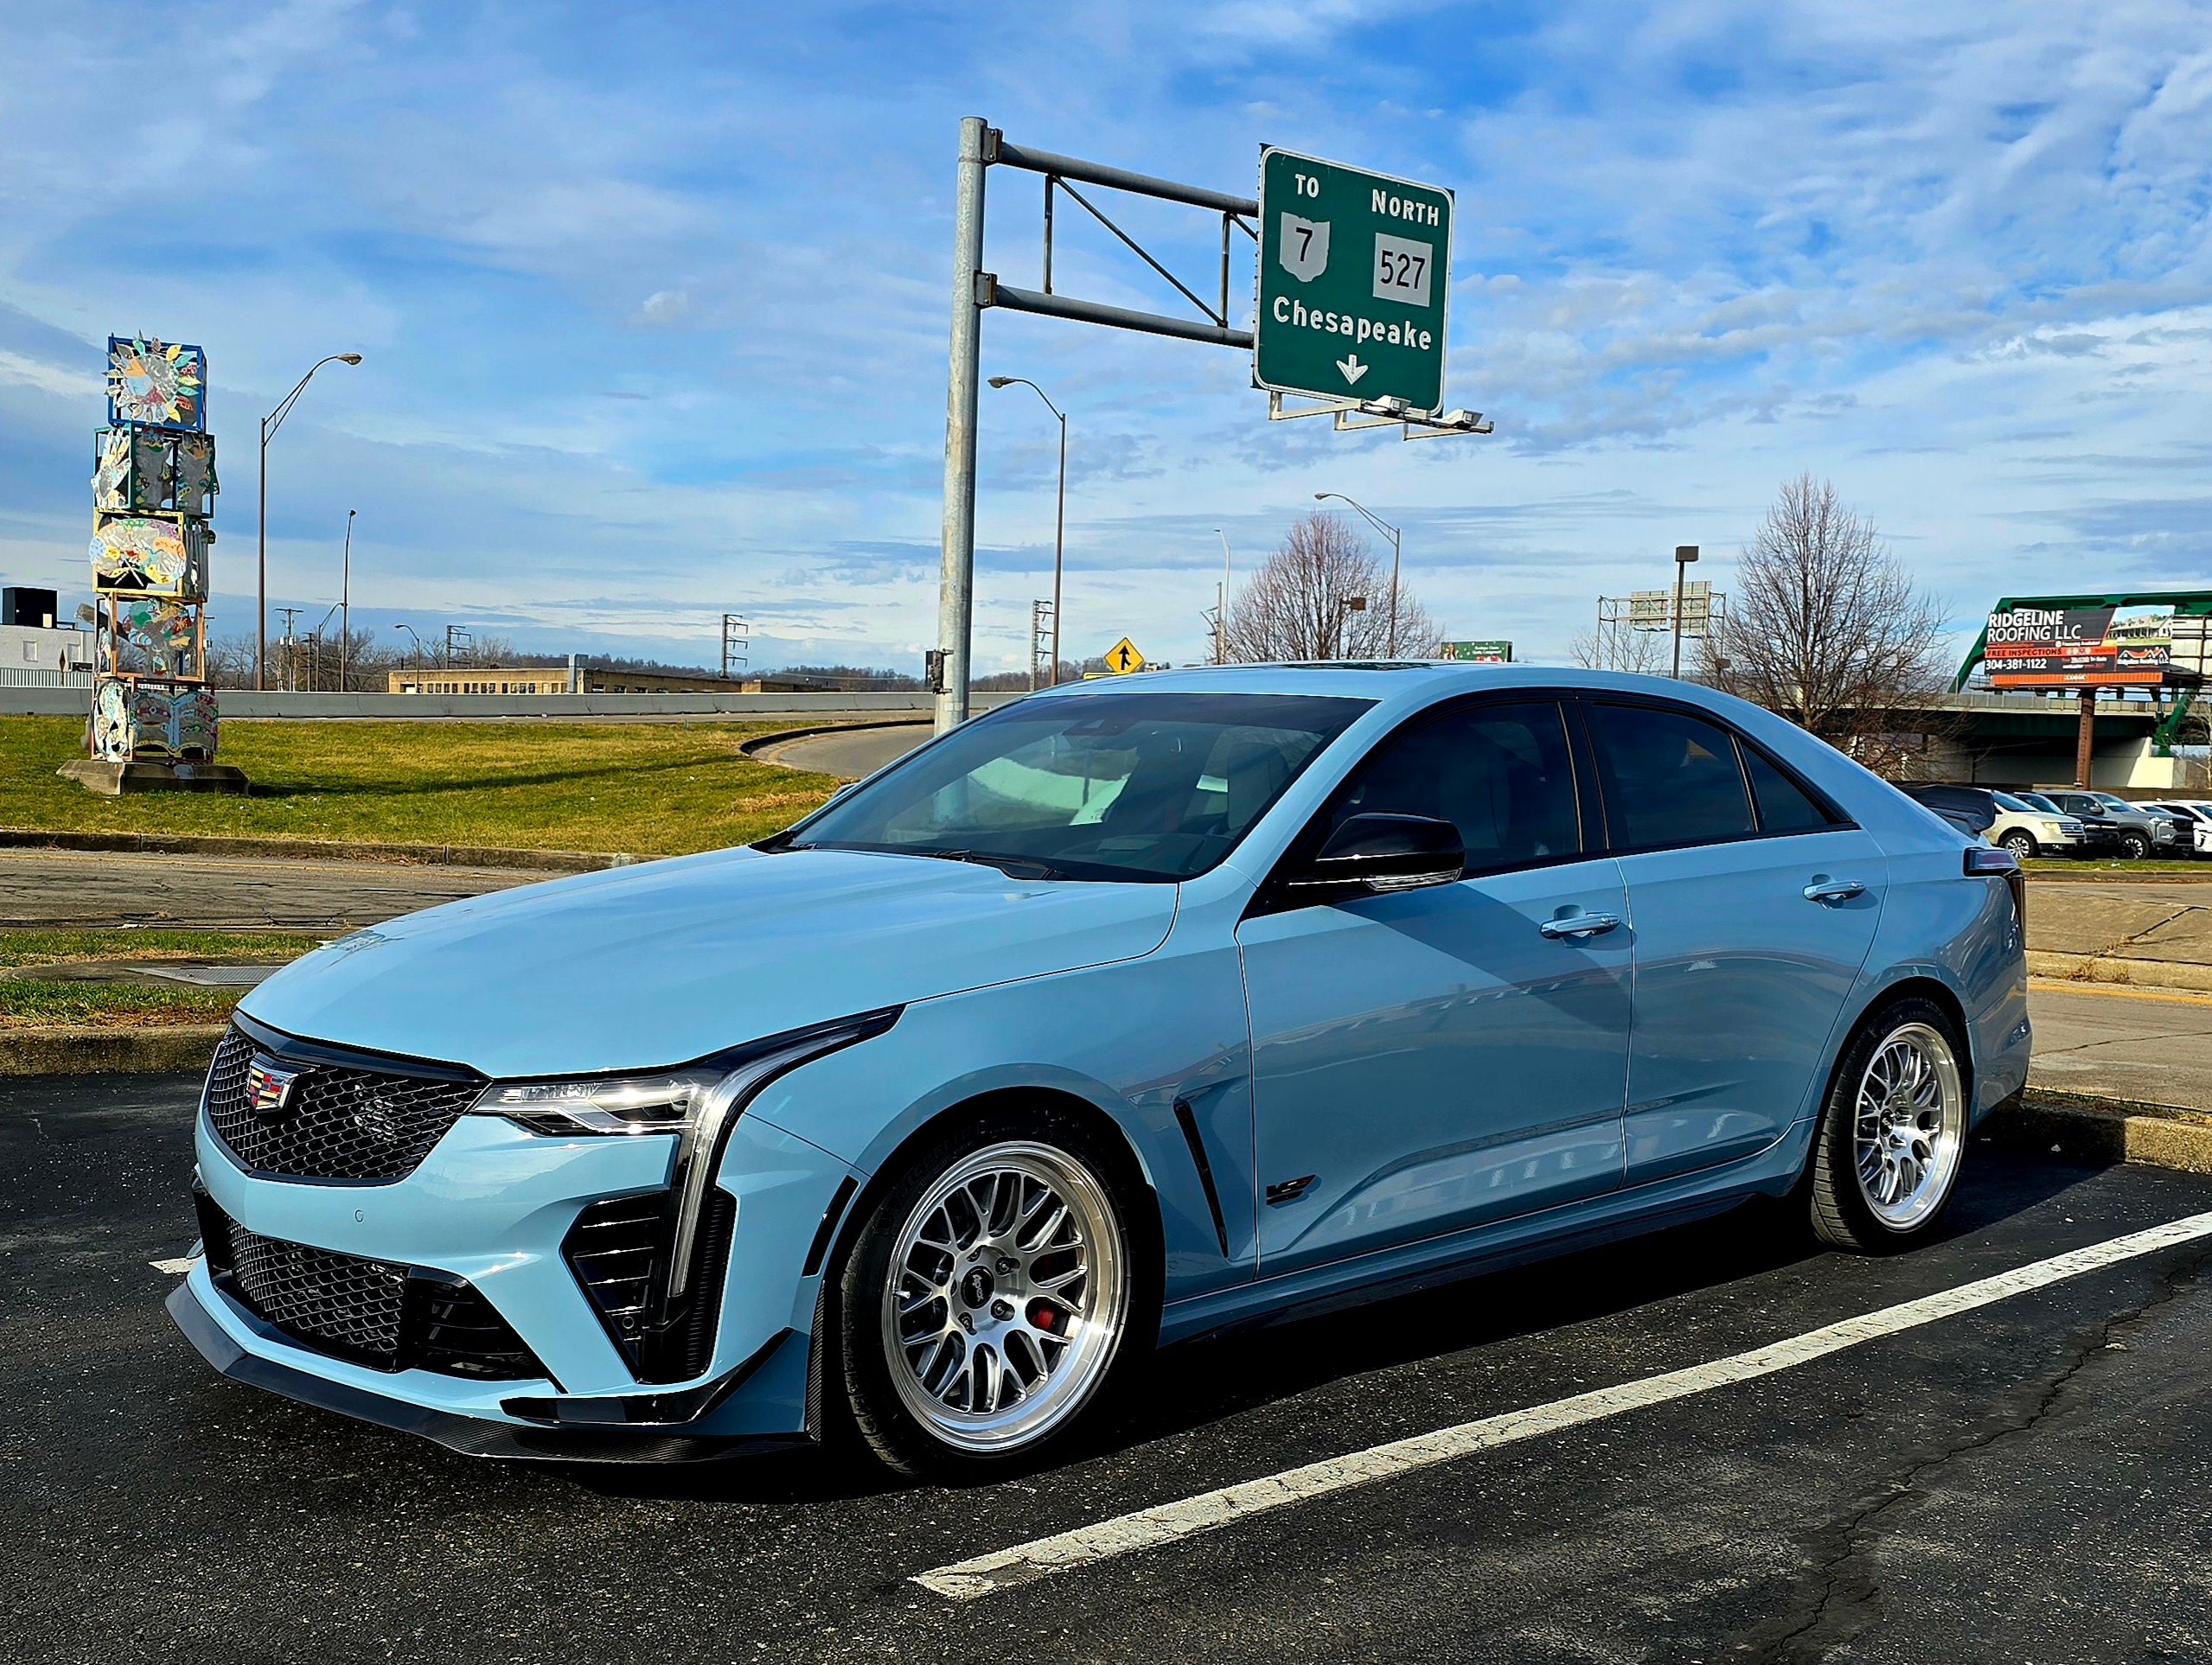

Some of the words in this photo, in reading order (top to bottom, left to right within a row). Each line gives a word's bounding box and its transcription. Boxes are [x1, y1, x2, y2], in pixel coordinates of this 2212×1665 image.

[1295, 173, 1320, 198] TO
[1371, 188, 1440, 226] NORTH
[1295, 226, 1314, 262] 7
[1380, 249, 1426, 290] 527
[1273, 296, 1432, 350] Chesapeake
[1988, 609, 2064, 628] RIDGELINE
[1987, 626, 2051, 642] ROOFING
[2055, 624, 2082, 640] LLC
[1985, 657, 2048, 670] 304-381-1122
[2009, 648, 2062, 656] INSPECTIONS
